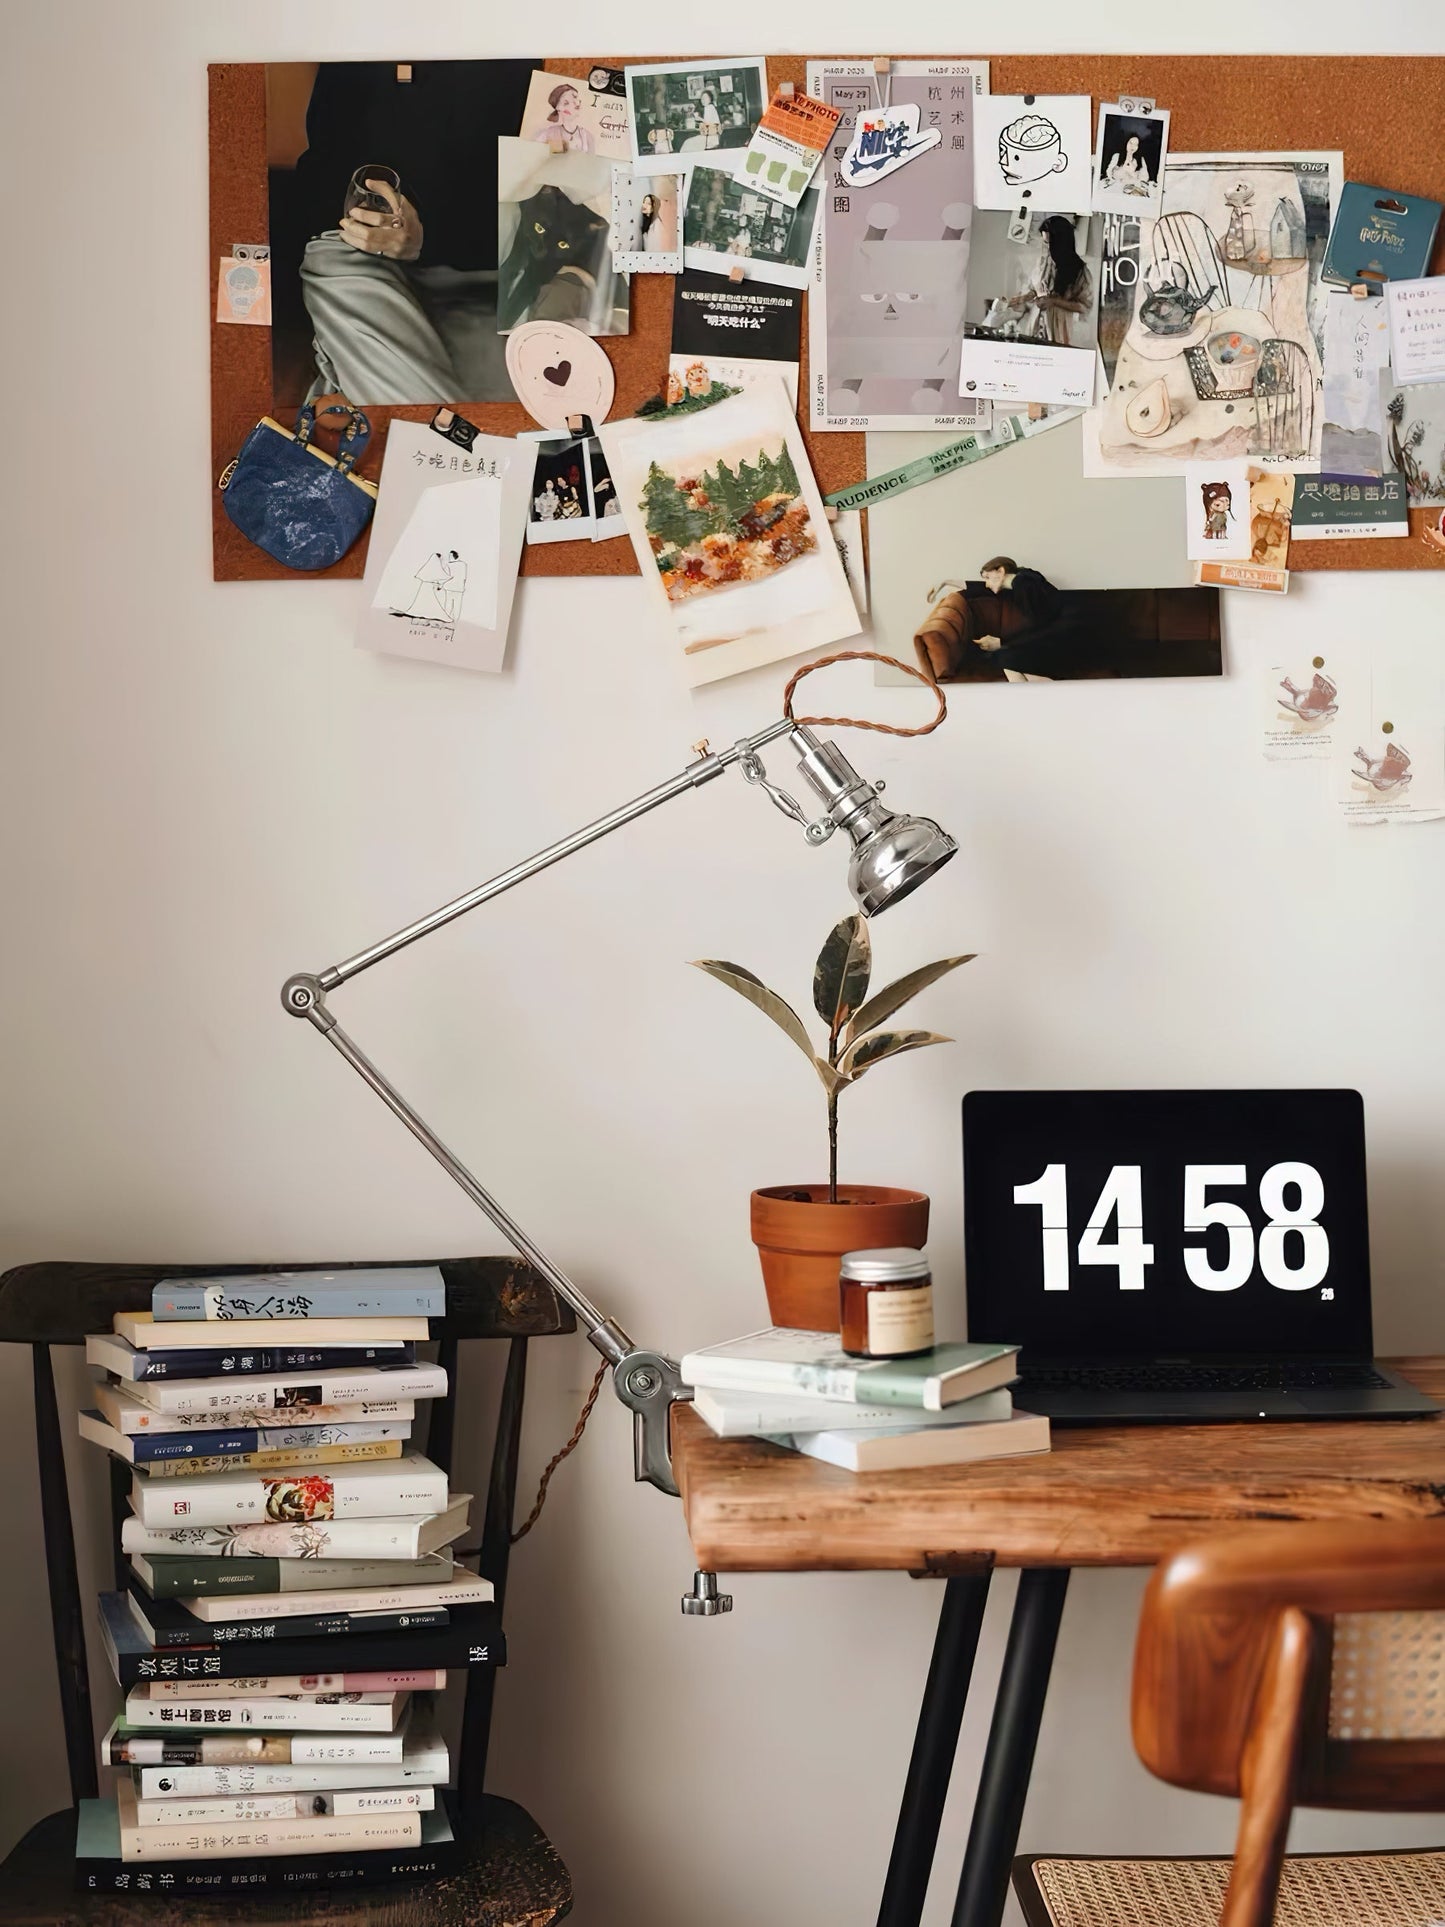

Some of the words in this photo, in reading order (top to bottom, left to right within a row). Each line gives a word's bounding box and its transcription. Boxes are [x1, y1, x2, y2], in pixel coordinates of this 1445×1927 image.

[835, 90, 855, 100] May
[804, 100, 840, 122] PHOTO
[835, 473, 910, 510] AUDIENCE
[1013, 1163, 1155, 1291] 14
[1183, 1161, 1330, 1292] 58
[213, 1294, 314, 1321] 纵身入山海
[138, 1656, 222, 1677] 敦煌石窟
